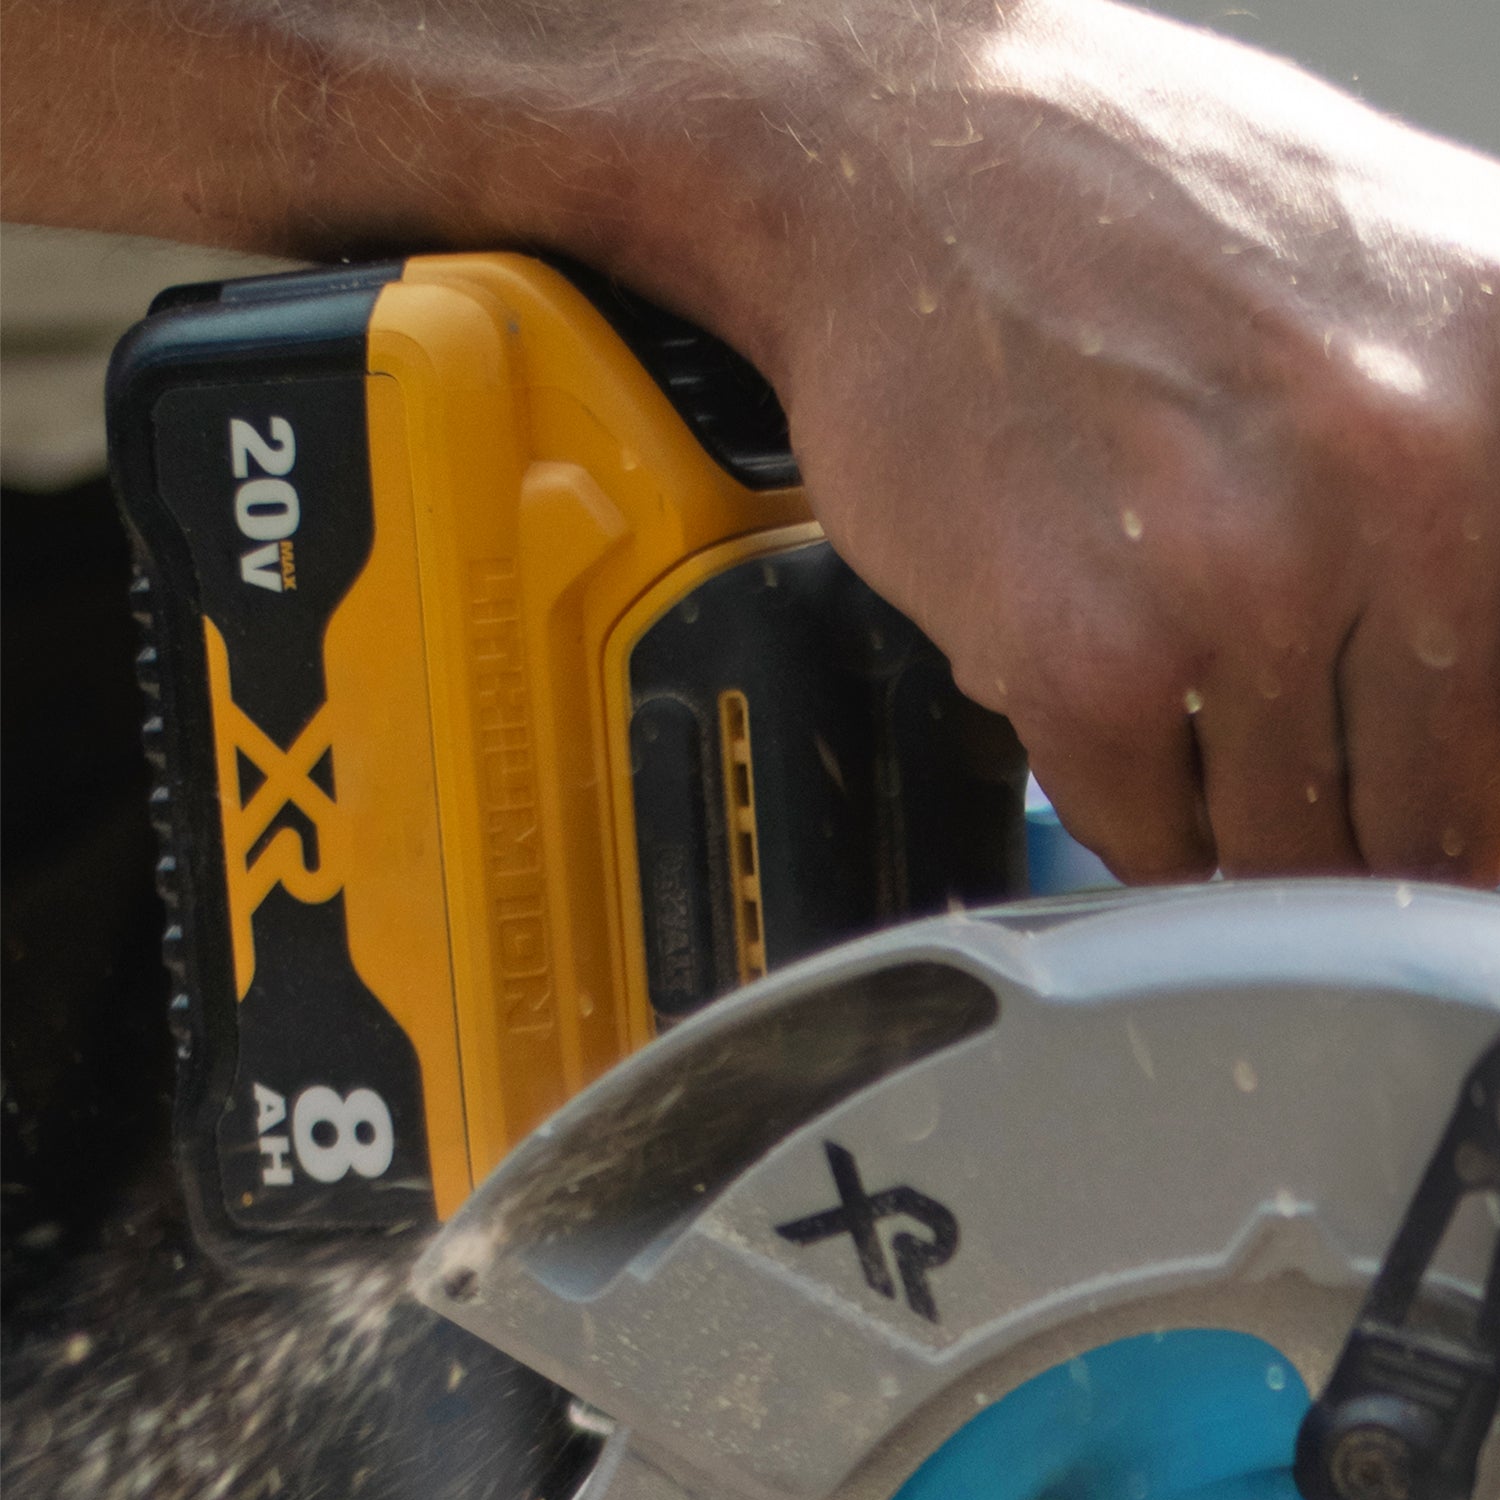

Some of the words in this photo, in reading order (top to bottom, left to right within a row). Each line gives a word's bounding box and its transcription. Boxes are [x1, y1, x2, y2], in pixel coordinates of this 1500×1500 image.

[229, 415, 300, 593] 20V
[279, 540, 297, 592] MAX
[467, 557, 541, 876] LITHIUM
[222, 696, 346, 916] XR
[498, 893, 555, 1036] ION
[253, 1081, 295, 1186] AH
[293, 1084, 395, 1184] 8
[773, 1138, 961, 1325] XR
